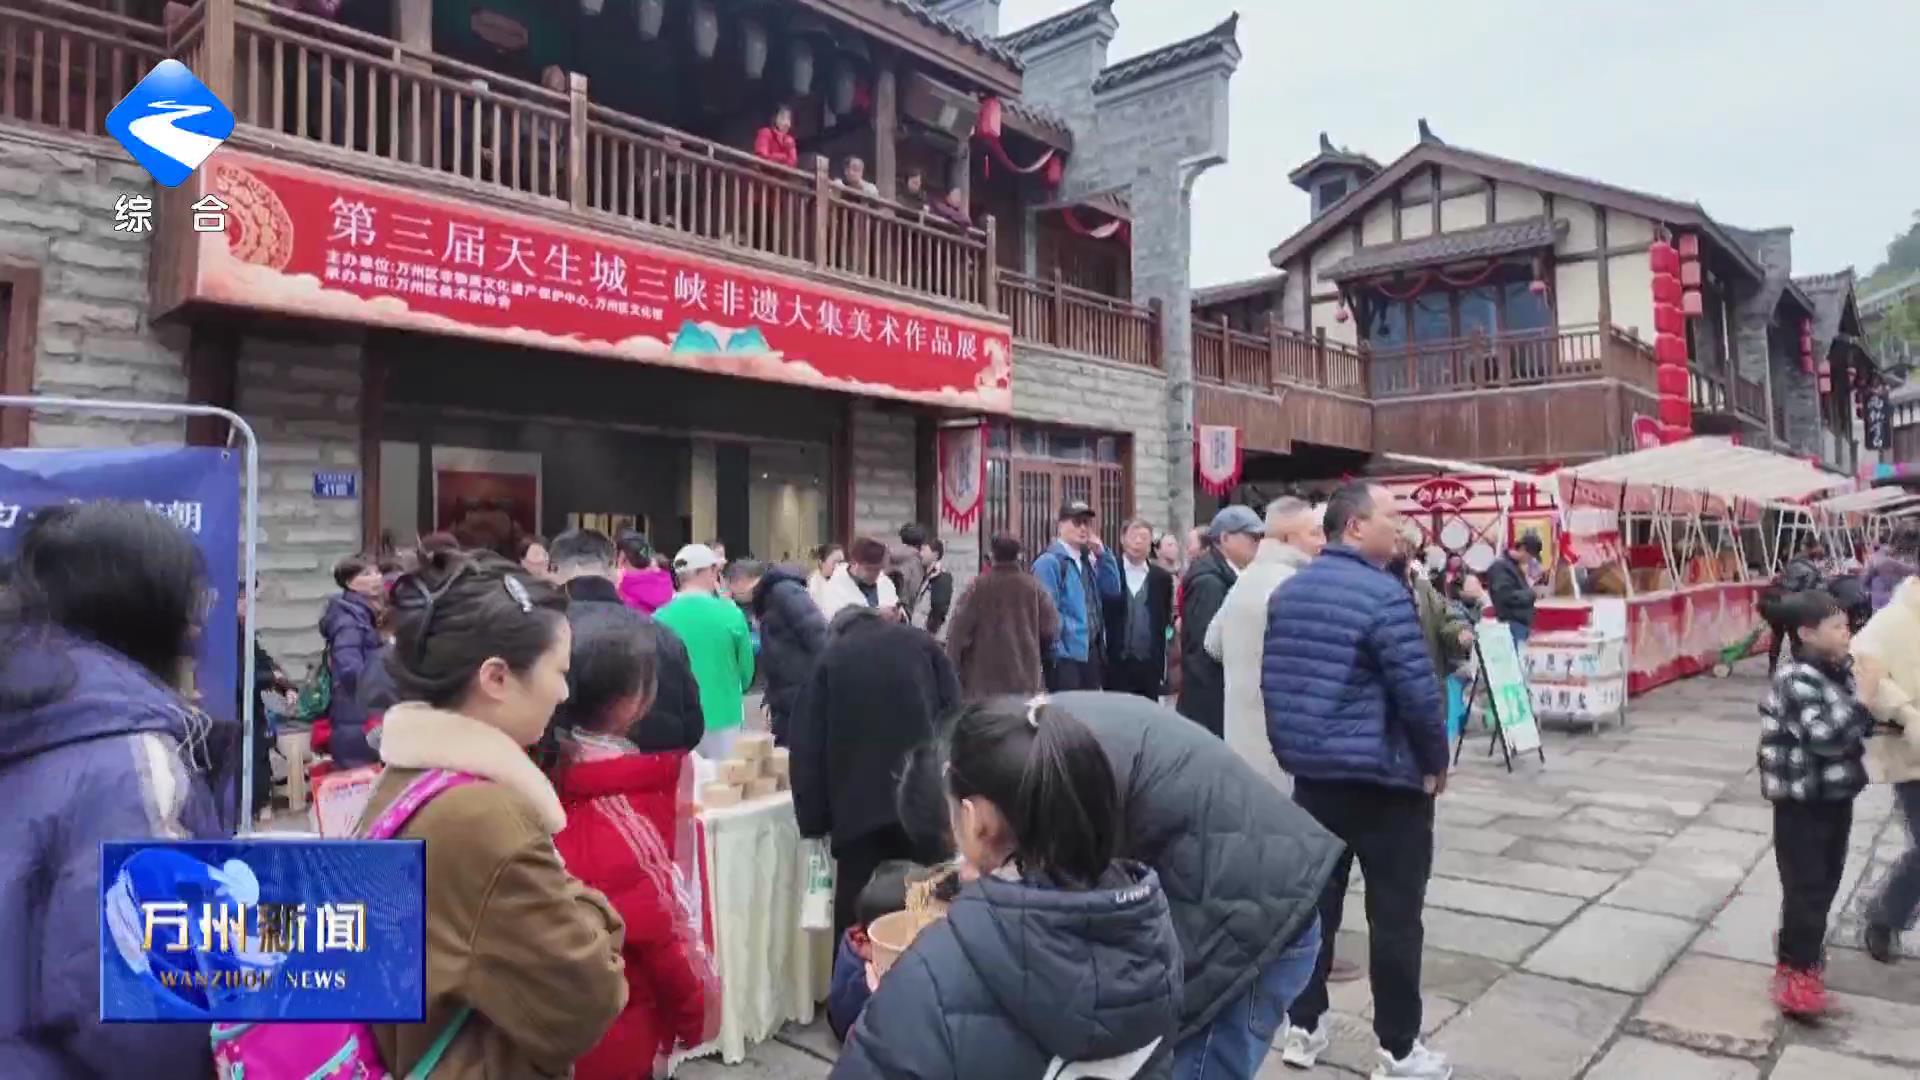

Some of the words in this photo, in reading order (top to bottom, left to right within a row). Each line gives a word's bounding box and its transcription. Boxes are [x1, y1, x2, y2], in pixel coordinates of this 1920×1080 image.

[327, 196, 978, 362] 第三届天生城三峡非遗大集美术作品展
